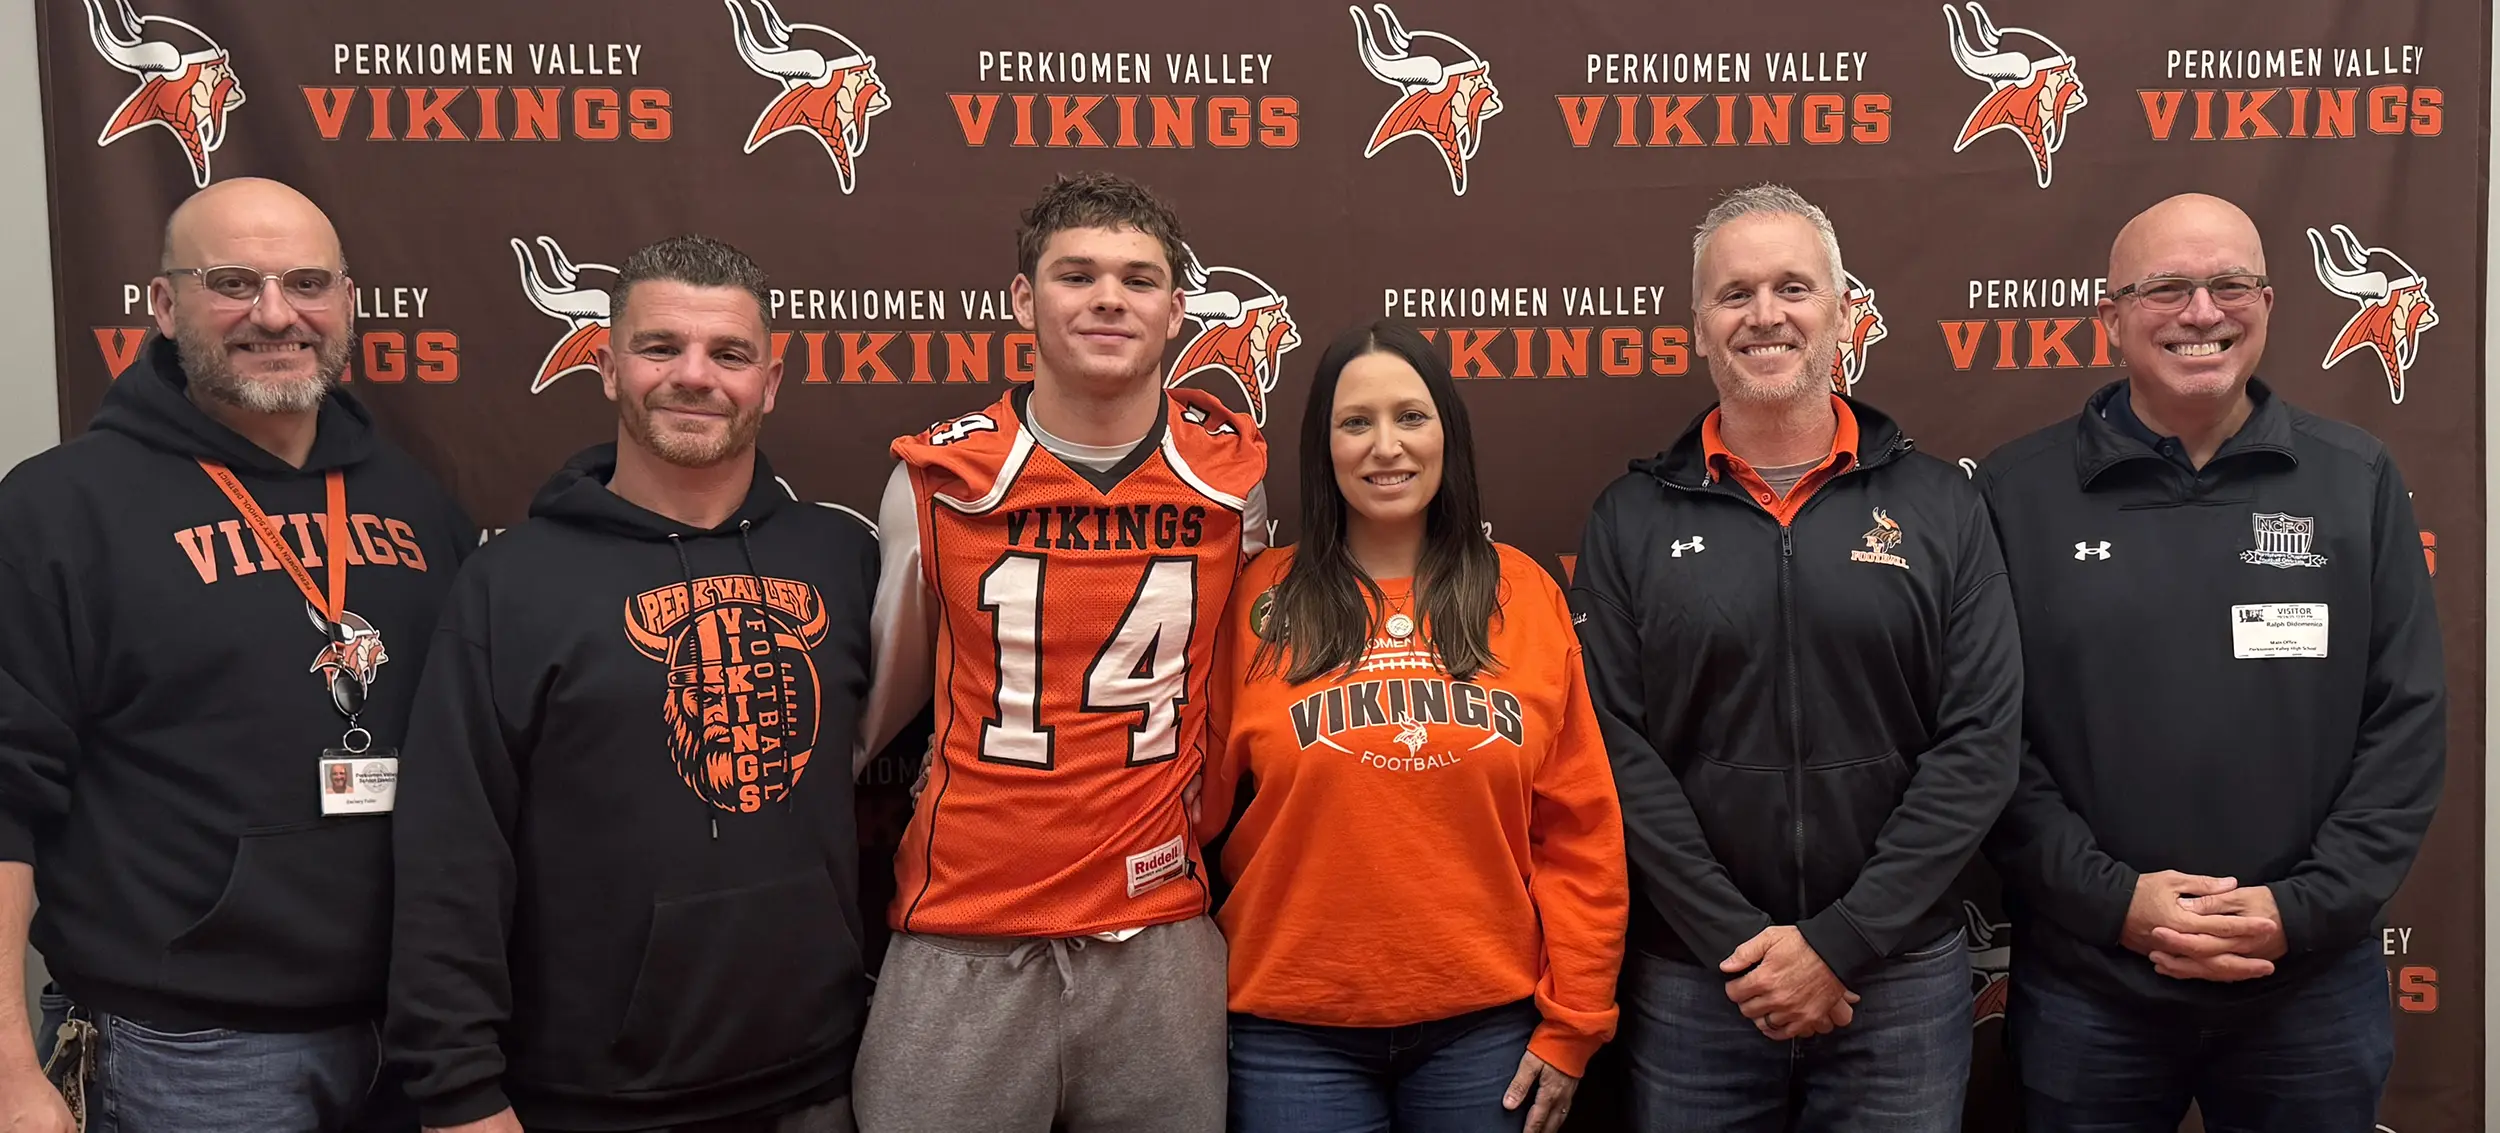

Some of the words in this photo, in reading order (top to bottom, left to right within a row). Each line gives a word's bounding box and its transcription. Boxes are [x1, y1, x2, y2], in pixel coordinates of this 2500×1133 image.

[334, 43, 514, 75] PERKIOMEN
[529, 44, 642, 75] VALLEY
[978, 51, 1151, 84] PERKIOMEN
[1165, 53, 1273, 84] VALLEY
[1587, 52, 1751, 83] PERKIOMEN
[1765, 51, 1868, 82] VALLEY
[2167, 48, 2323, 79] PERKIOMEN
[2333, 45, 2423, 77] VALLEY
[299, 85, 673, 141] VIKINGS
[946, 92, 1300, 149] VIKINGS
[1554, 92, 1892, 148] VIKINGS
[2136, 84, 2445, 140] VIKINGS
[356, 287, 429, 319] LLEY
[770, 289, 945, 320] PERKIOMEN
[960, 290, 1014, 320] VAL
[1384, 286, 1548, 318] PERKIOMEN
[1562, 286, 1665, 316] VALLEY
[1969, 277, 2107, 309] PERKIOME
[770, 330, 1036, 385] IKING
[1417, 325, 1690, 380] KINGS
[1937, 317, 2127, 371] VIKI
[217, 470, 244, 500] DISTRICT
[242, 500, 265, 527] SCHOOL
[1007, 504, 1206, 550] VIKINGS
[2259, 518, 2308, 534] NCFO
[263, 526, 285, 552] VALLEY
[283, 550, 312, 591] PERKIOMEN
[640, 579, 714, 633] PERK
[715, 577, 811, 622] VALLEY
[2277, 607, 2312, 615] VISITOR
[978, 550, 1198, 771] 14
[716, 608, 761, 813] VIKINGS
[746, 618, 784, 801] FOOTBALL
[1288, 678, 1523, 750] VIKINGS
[1360, 750, 1461, 772] FOOTBALL
[1135, 845, 1179, 875] Riddell
